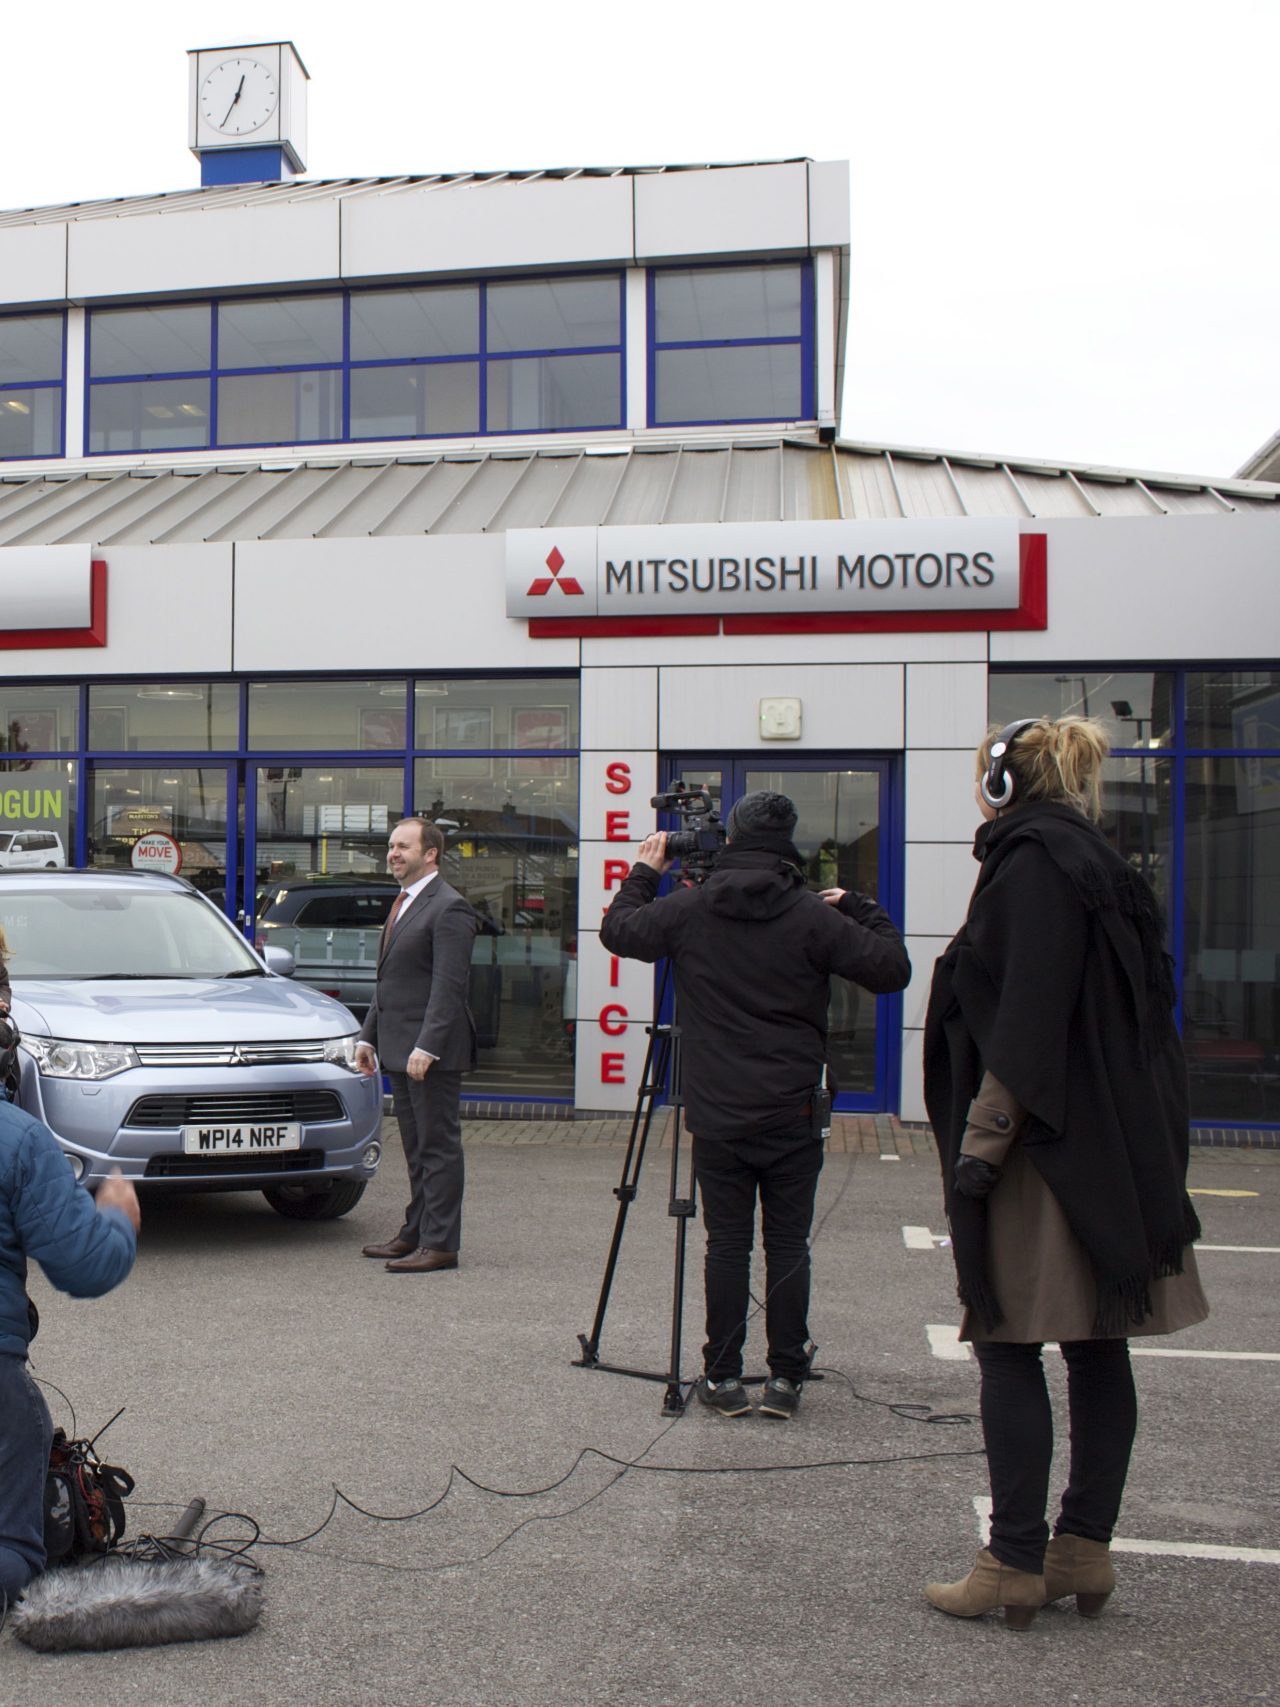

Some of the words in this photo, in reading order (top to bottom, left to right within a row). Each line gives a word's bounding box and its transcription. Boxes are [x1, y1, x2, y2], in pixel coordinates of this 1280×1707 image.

[605, 554, 818, 595] MITSUBISHI
[837, 551, 996, 589] MOTORS
[138, 847, 173, 858] MOVE
[598, 762, 632, 1084] SERICE
[198, 1128, 244, 1150] WP14
[249, 1126, 288, 1148] NRF
